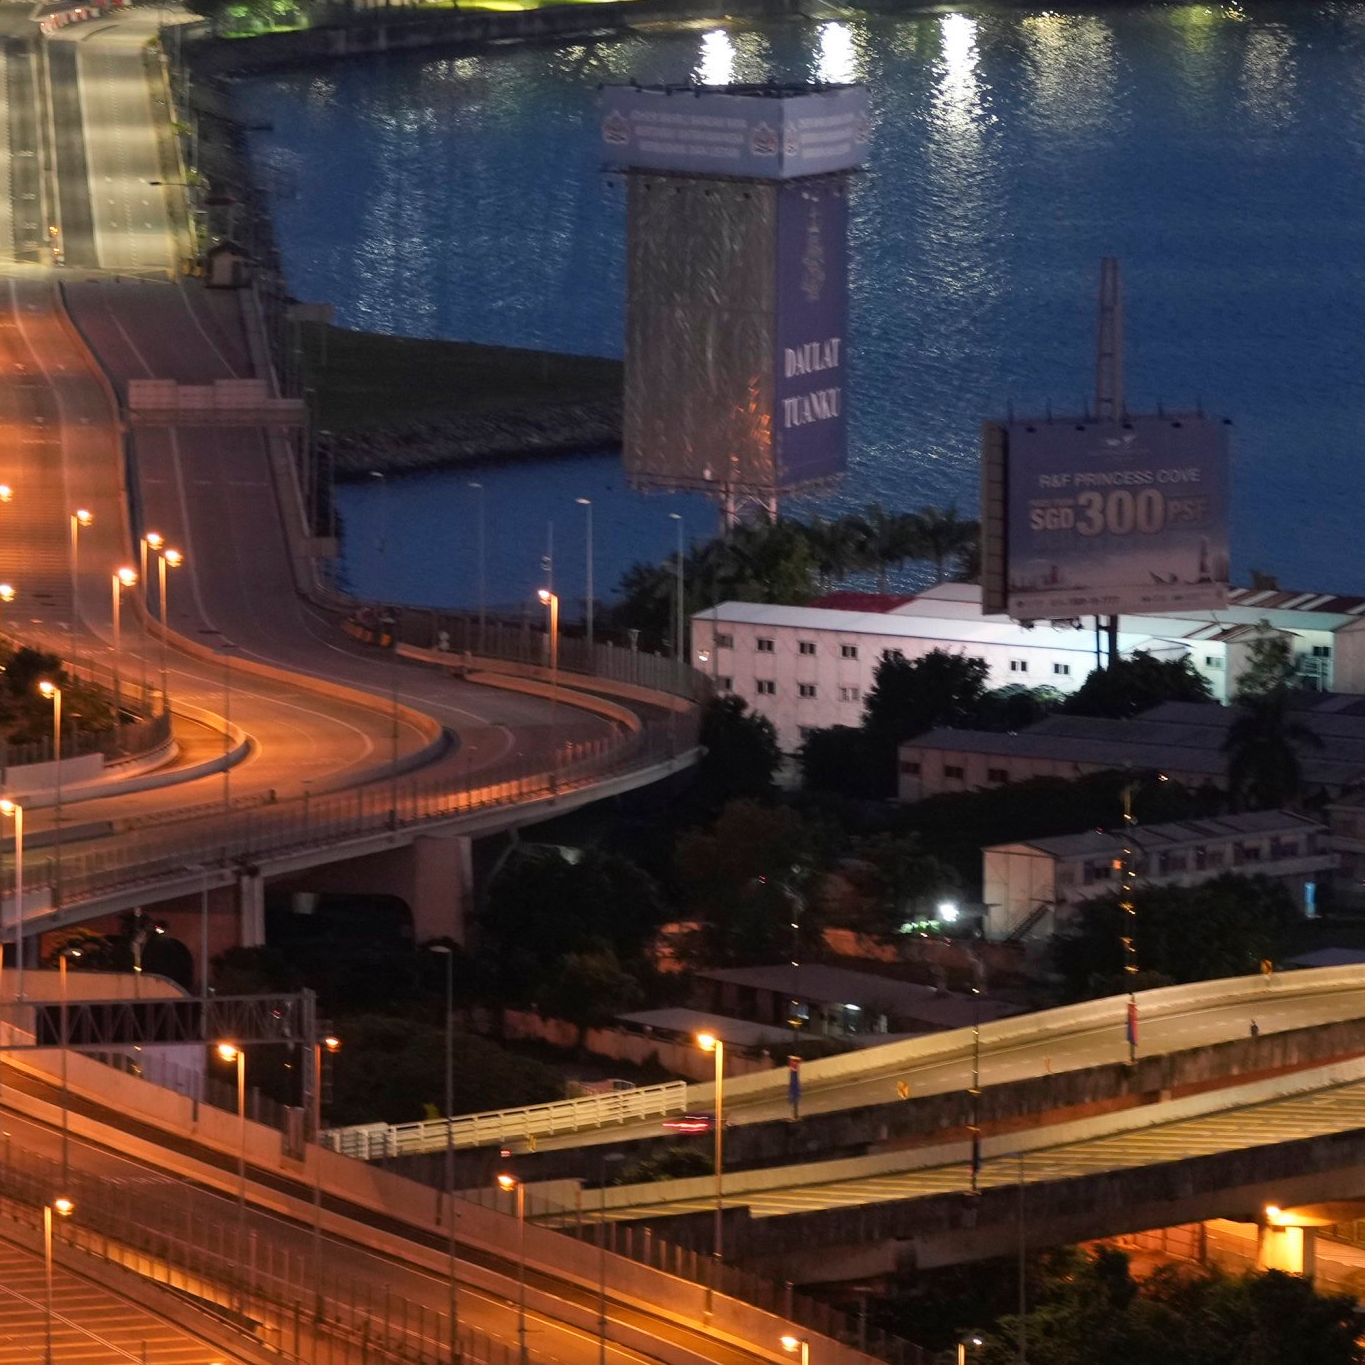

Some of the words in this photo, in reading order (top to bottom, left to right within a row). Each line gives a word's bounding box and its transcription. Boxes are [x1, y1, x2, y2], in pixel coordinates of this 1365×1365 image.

[784, 337, 841, 378] DAULAT
[782, 387, 841, 428] TUANKU
[1039, 472, 1072, 489] R&F
[1074, 469, 1154, 488] PRINCESS
[1157, 467, 1202, 484] COVE
[1030, 507, 1075, 531] SGD
[1076, 489, 1166, 536] 300
